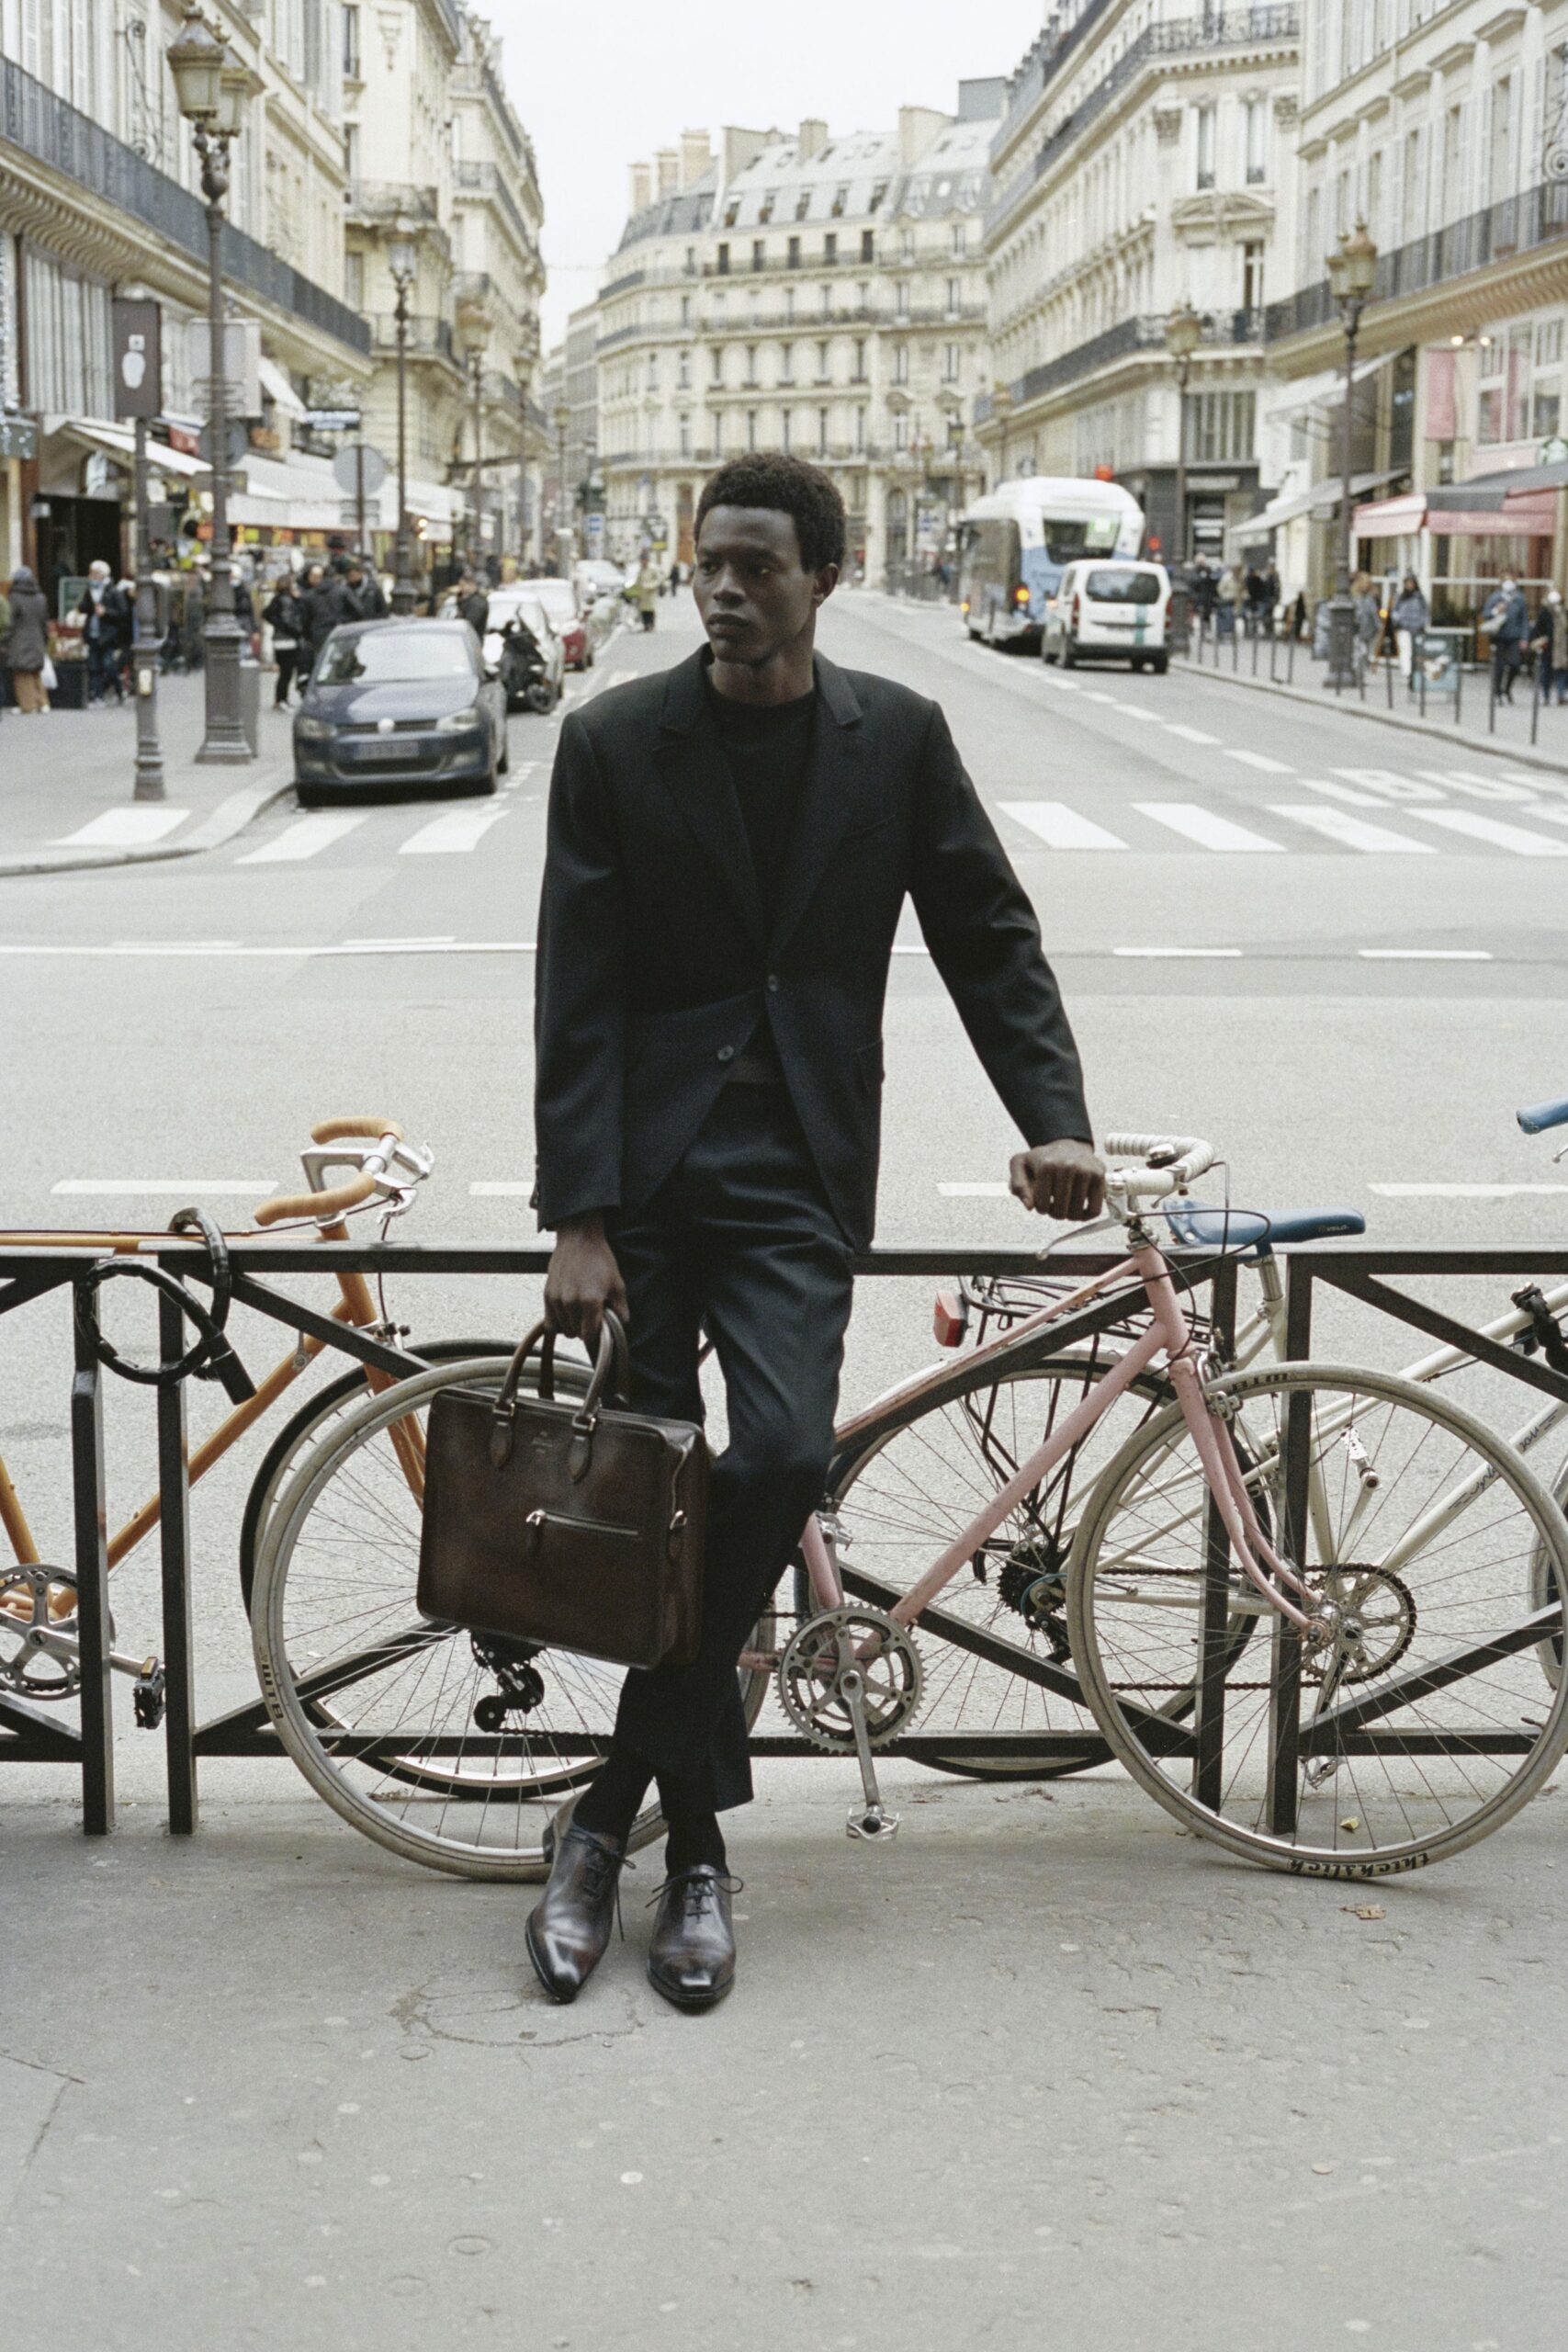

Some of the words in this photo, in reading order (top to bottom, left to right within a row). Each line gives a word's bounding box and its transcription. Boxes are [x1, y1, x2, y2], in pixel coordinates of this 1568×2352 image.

[1232, 1373, 1288, 1393] WTB
[262, 1664, 284, 1719] WTB
[1290, 1851, 1430, 1878] thickslick
